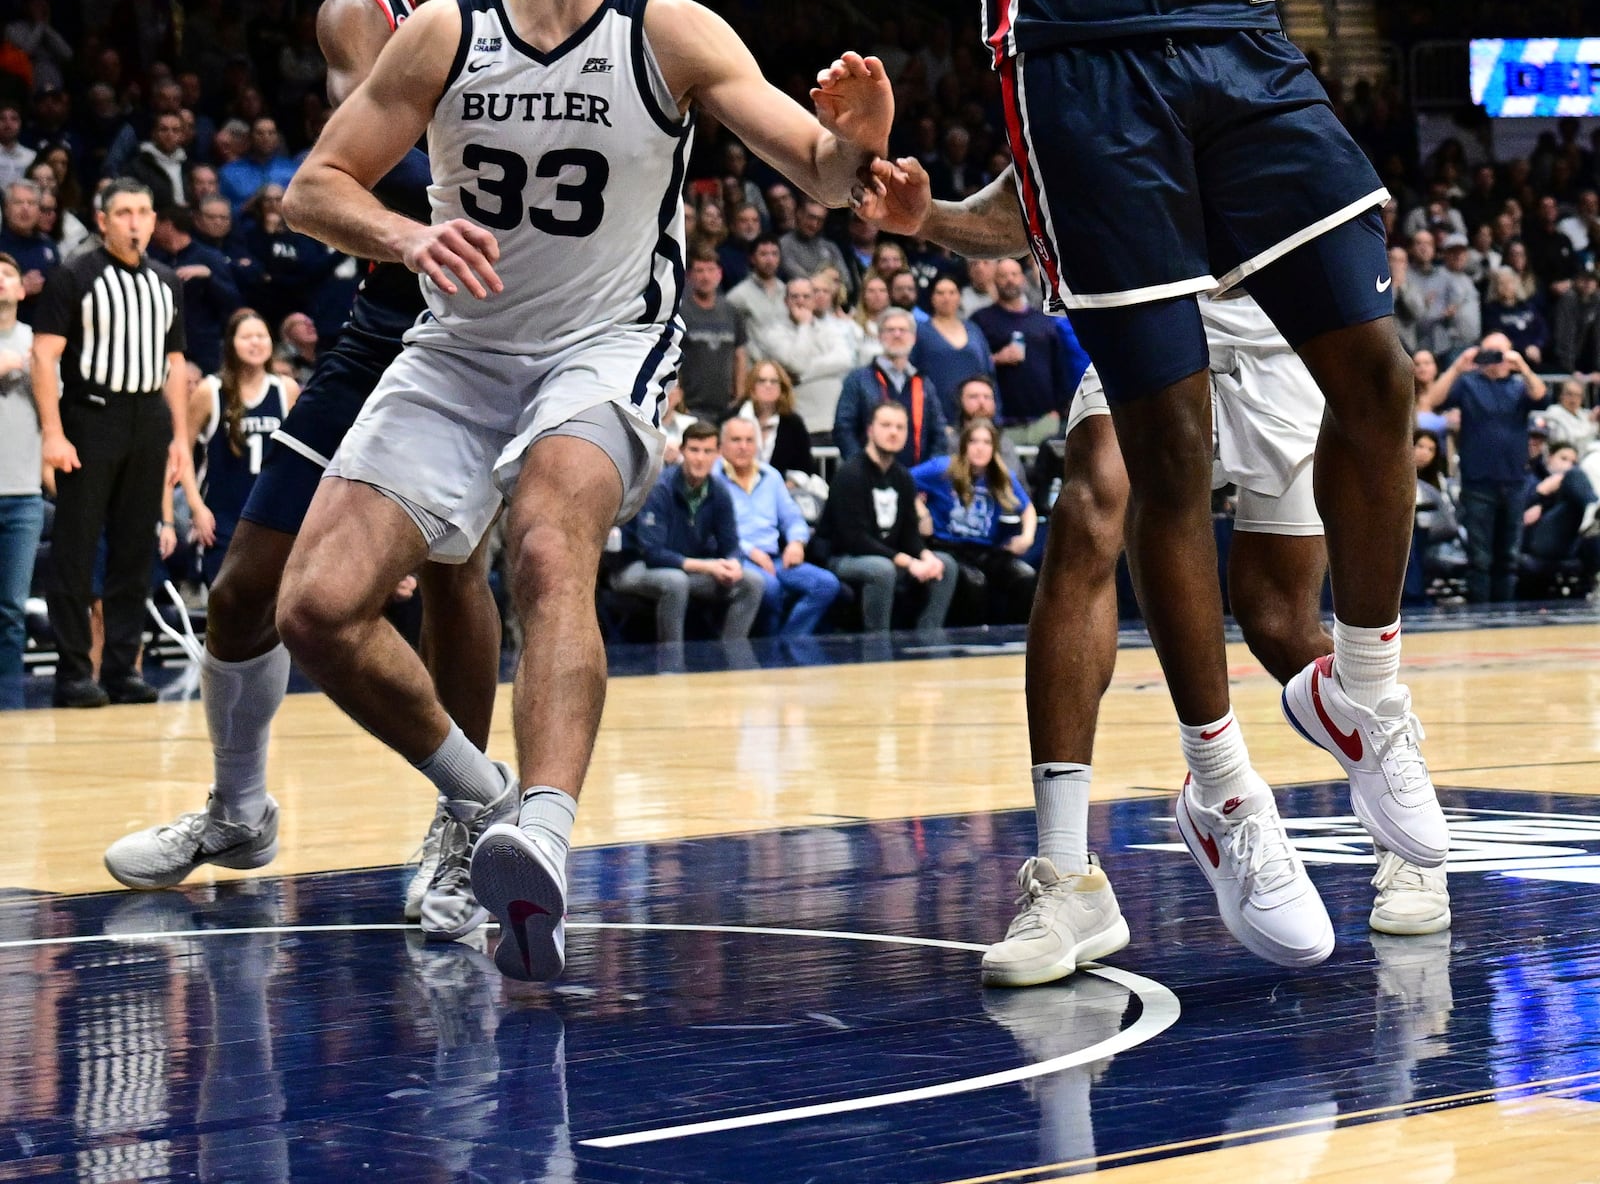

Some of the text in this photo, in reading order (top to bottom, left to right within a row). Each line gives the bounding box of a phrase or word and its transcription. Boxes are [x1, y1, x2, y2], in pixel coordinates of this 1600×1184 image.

[582, 63, 614, 72] EAST
[461, 92, 612, 128] BUTLER
[460, 143, 609, 237] 33
[246, 433, 263, 474] 1
